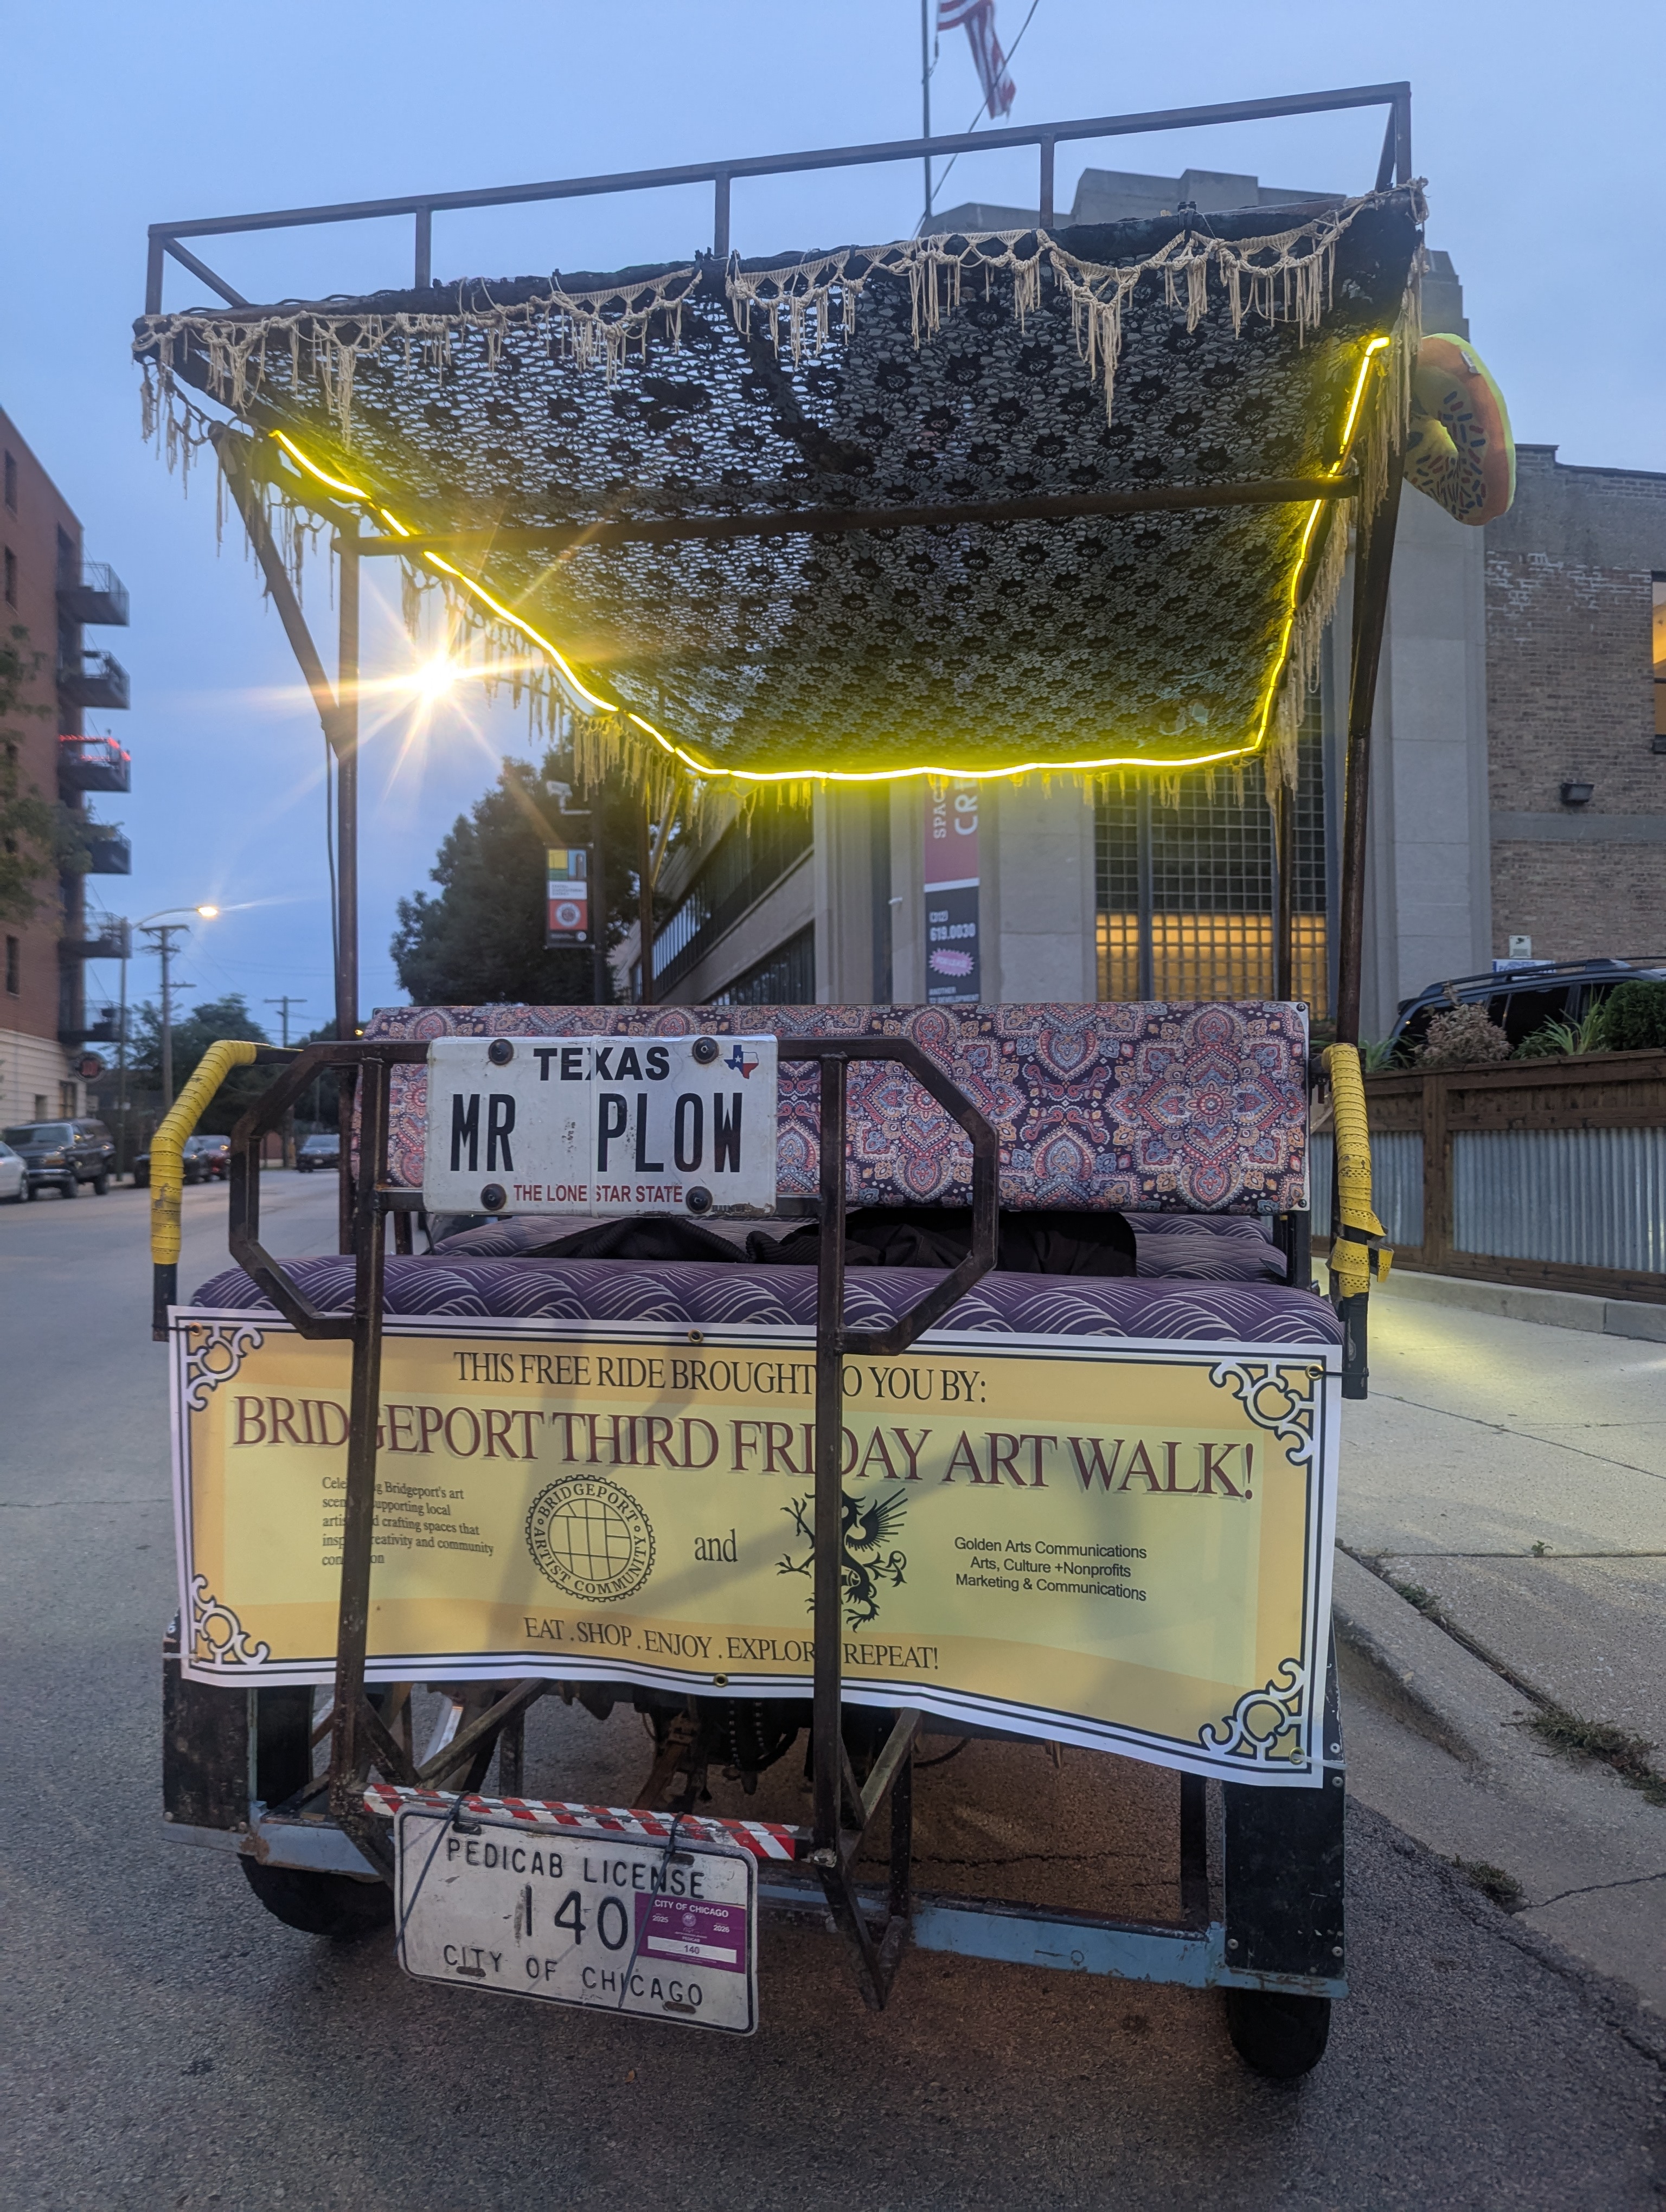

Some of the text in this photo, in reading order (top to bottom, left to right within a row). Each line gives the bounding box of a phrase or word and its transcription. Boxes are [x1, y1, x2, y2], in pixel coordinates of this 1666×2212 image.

[533, 1046, 670, 1081] TEXAS
[450, 1092, 743, 1173] MR PLOW
[514, 1185, 683, 1203] THE LONE STAR STATE
[454, 1352, 986, 1403] THIS FREE RIDE BROUGHT O YOU BY:
[553, 1412, 719, 1469] THIRD
[942, 1430, 1058, 1488] ART
[1067, 1437, 1254, 1500] WALK!
[384, 1481, 446, 1499] Bridgeport's
[450, 1488, 464, 1500] art
[537, 1483, 638, 1522] BRIDGEPORT
[373, 1500, 424, 1516] upporting
[426, 1502, 451, 1515] local
[382, 1517, 421, 1532] crafting
[424, 1522, 457, 1533] spaces
[459, 1522, 480, 1535] that
[416, 1536, 435, 1548] and
[437, 1540, 494, 1557] community
[535, 1527, 646, 1594] ARTIST COMMUNITY
[694, 1528, 738, 1562] and
[954, 1536, 1147, 1559] Golden Arts Communications
[970, 1556, 1000, 1572] Arts,
[1003, 1558, 1051, 1573] Culture
[956, 1573, 1146, 1602] Marketing & Communications
[523, 1617, 565, 1640] EAT
[577, 1622, 633, 1647] SHOP
[645, 1631, 713, 1659] ENJOY
[727, 1637, 814, 1662] EXPLOR
[843, 1643, 939, 1670] REPEAT!
[447, 1837, 704, 1899] PEDICAB LICENSE
[524, 1884, 628, 1951] 140
[652, 1915, 669, 1923] 2025
[654, 1899, 729, 1918] CITY OF CHICAGO
[684, 1945, 700, 1954] 140
[444, 1944, 703, 2006] CITY OF CHICAGO
